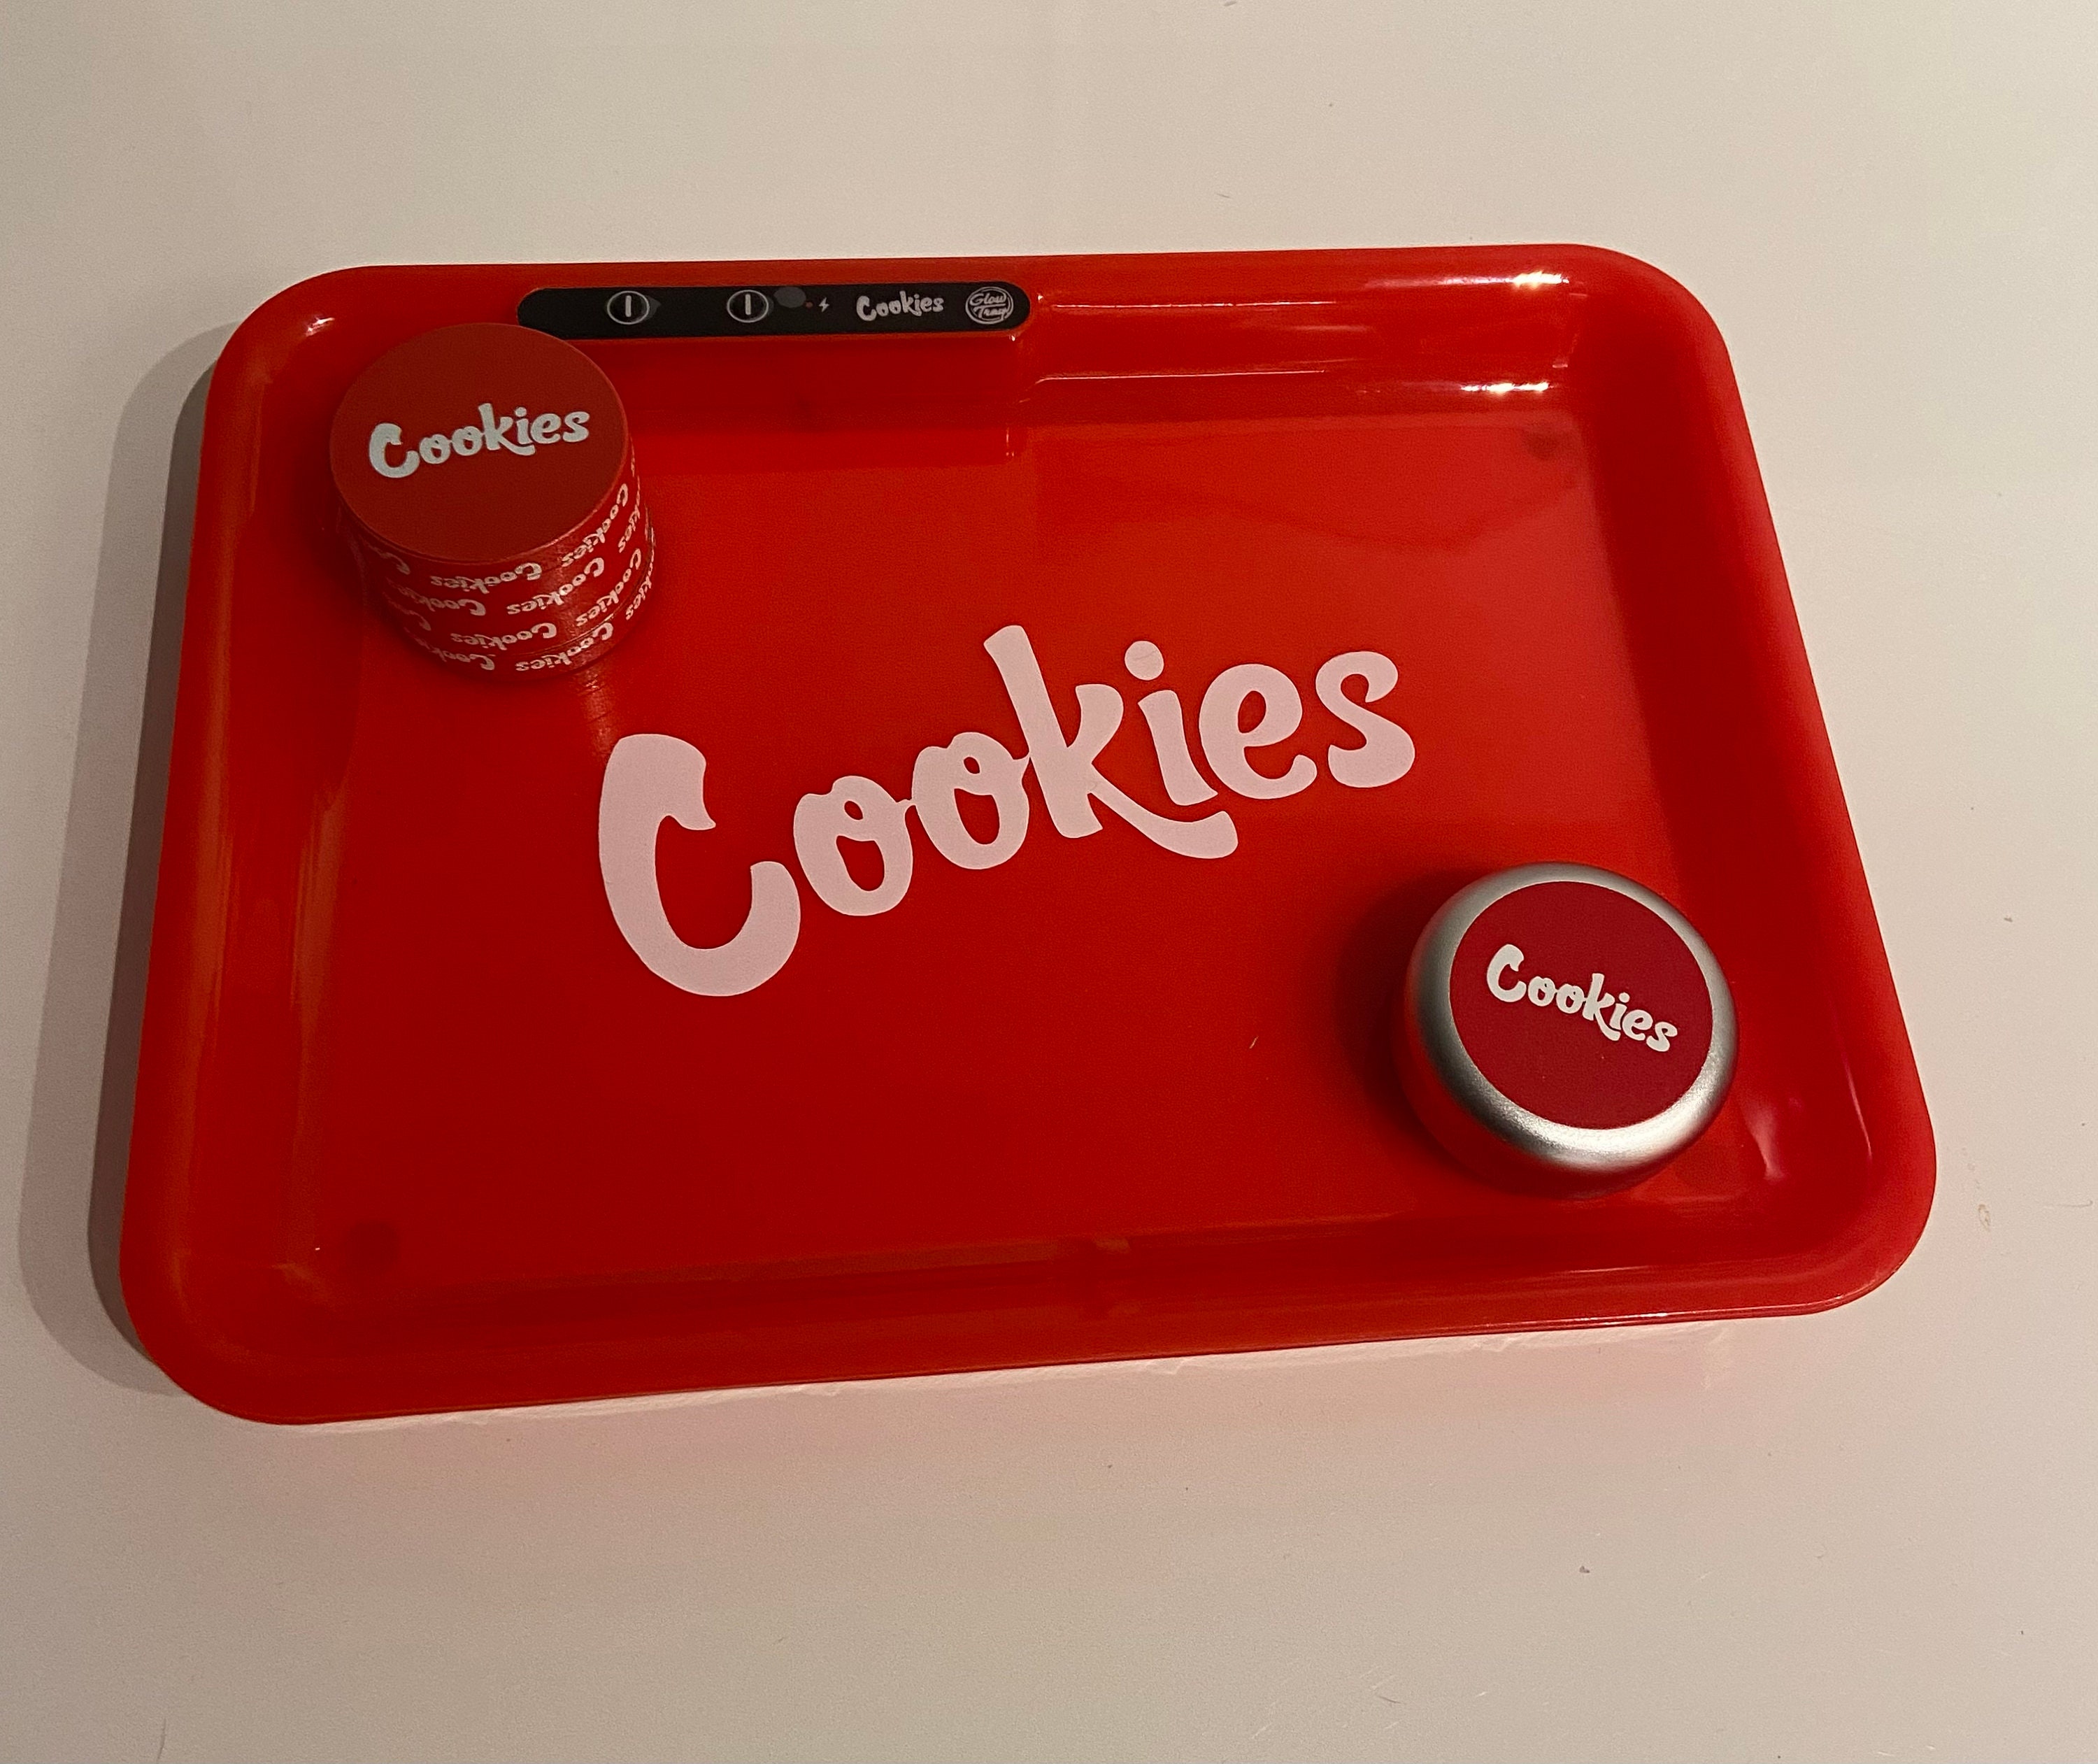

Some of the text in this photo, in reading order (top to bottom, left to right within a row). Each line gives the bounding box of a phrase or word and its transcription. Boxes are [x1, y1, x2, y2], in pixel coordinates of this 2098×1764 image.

[856, 290, 944, 321] Cookies
[969, 292, 1007, 306] Glow
[369, 403, 590, 478] Cookies
[562, 483, 628, 567] Cookies
[430, 562, 542, 594] Cookies
[450, 548, 641, 650] Cookies Cookies
[506, 557, 604, 615] Cookies
[515, 622, 613, 671] Cookies
[598, 625, 1415, 997] Cookies
[1487, 944, 1678, 1052] Cookies
